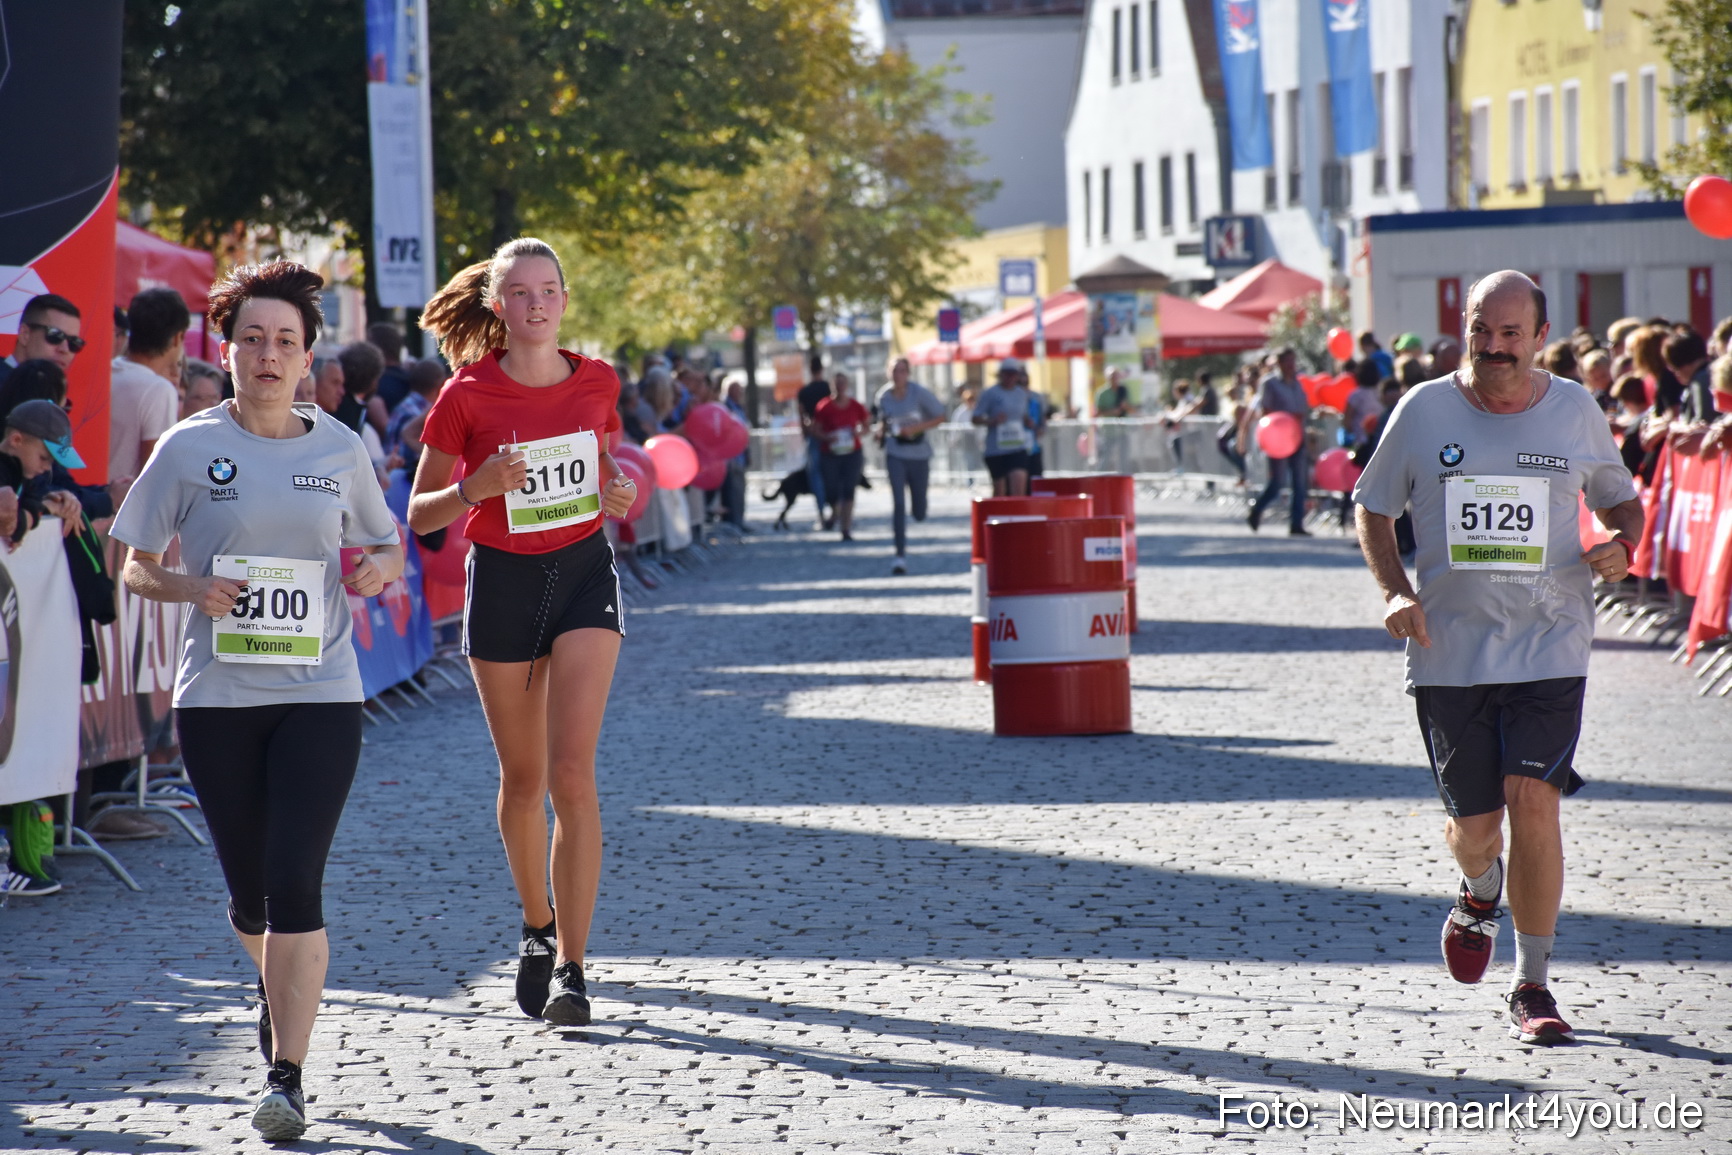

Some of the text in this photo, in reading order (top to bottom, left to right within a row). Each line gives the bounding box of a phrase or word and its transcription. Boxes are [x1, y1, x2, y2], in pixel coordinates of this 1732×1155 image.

[529, 443, 572, 460] BOCK
[1516, 453, 1569, 470] BOCK
[519, 458, 586, 496] 5110
[1438, 470, 1466, 479] PARTL
[209, 487, 239, 496] PARTL
[292, 475, 341, 495] BOCK
[1475, 484, 1520, 496] BOCK
[528, 491, 575, 505] PARTL Neumarkt
[535, 503, 579, 521] Victoria
[1460, 502, 1534, 532] 5129
[1467, 547, 1527, 561] Friedhelm
[247, 566, 294, 580] BOCK
[1490, 574, 1539, 585] Stadtlauf
[230, 587, 309, 620] 5100
[236, 623, 293, 632] PARTL Neumarkt
[244, 637, 293, 653] Yvonne
